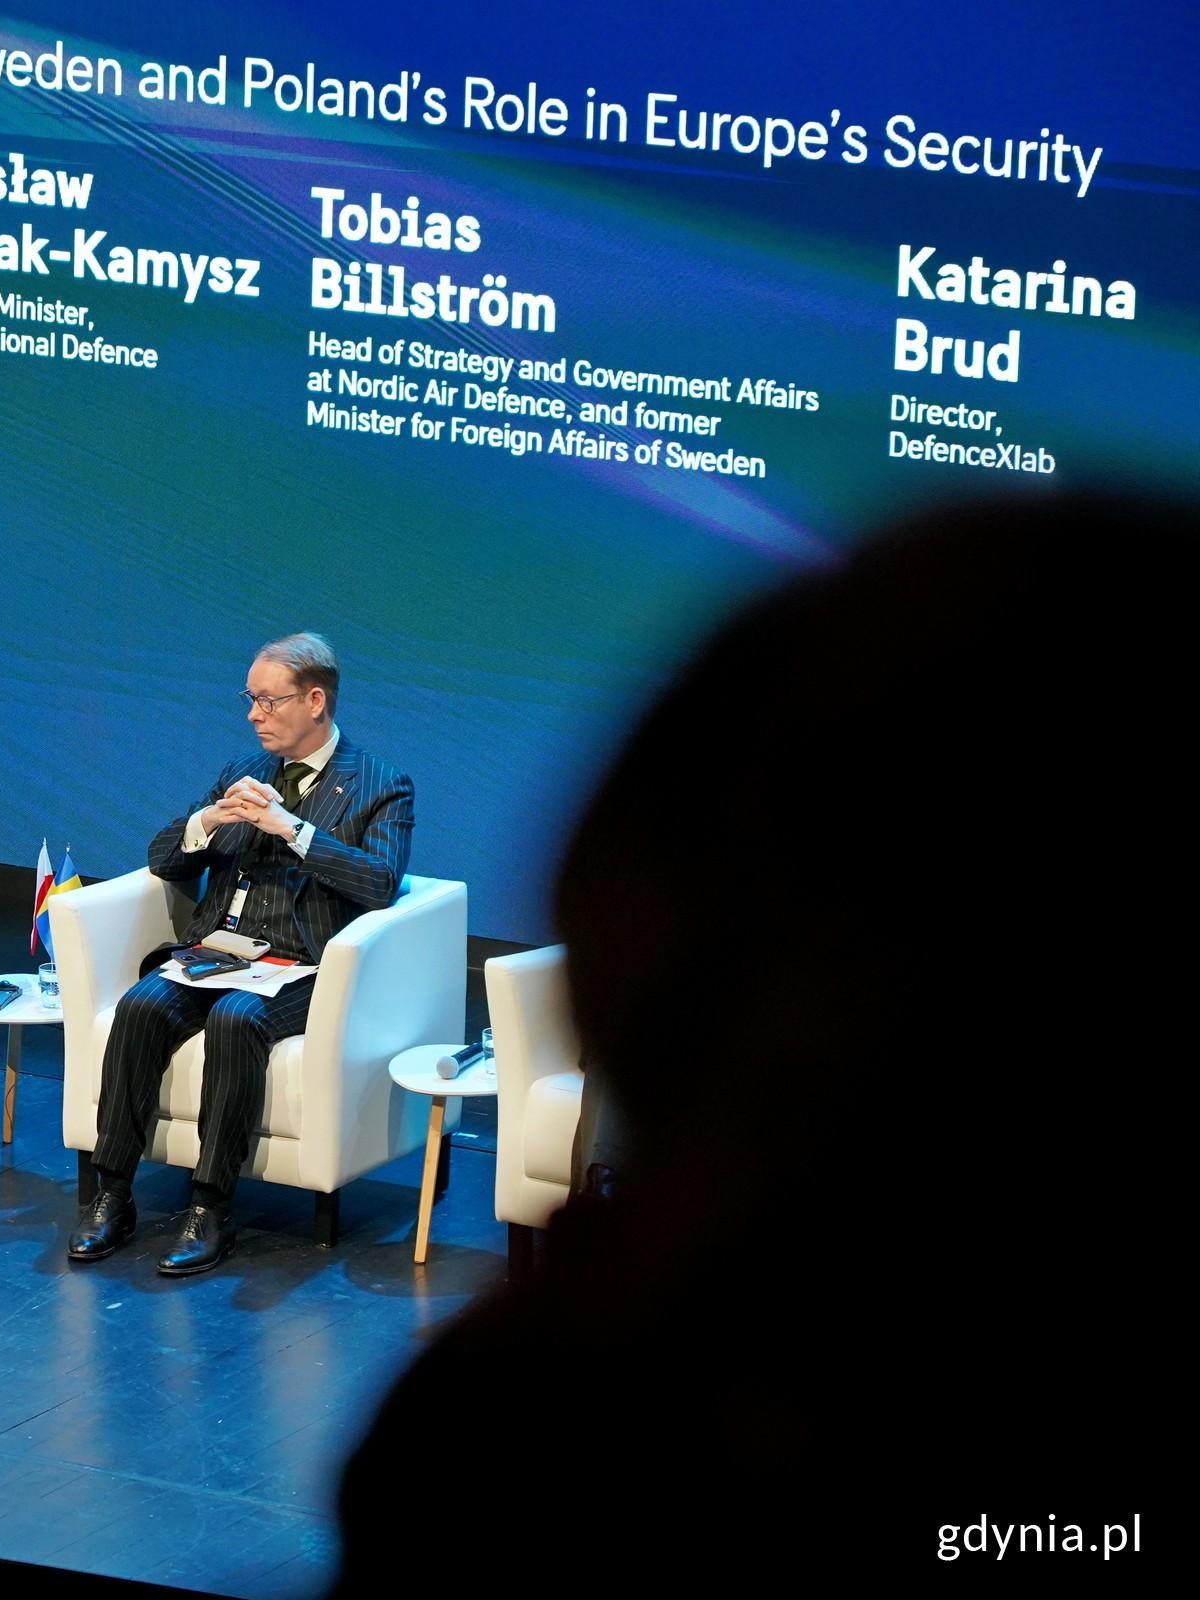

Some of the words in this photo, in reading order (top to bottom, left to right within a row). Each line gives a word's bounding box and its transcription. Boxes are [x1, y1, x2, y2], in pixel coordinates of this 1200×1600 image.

[138, 54, 227, 106] and
[244, 57, 448, 125] Poland’s
[464, 77, 569, 136] Role
[586, 87, 628, 142] in
[646, 93, 868, 169] Europe’s
[883, 115, 1103, 198] Security
[311, 187, 482, 253] Tobias
[311, 257, 556, 333] Billström
[897, 245, 1136, 320] Katarina
[62, 333, 159, 369] Defence
[308, 331, 373, 362] Head
[378, 339, 406, 366] of
[408, 342, 515, 383] Strategy
[518, 357, 567, 384] and
[573, 359, 732, 402] Government
[735, 377, 820, 412] Affairs
[894, 317, 1021, 383] Brud
[306, 368, 333, 393] at
[338, 368, 419, 402] Nordic
[423, 379, 459, 407] Air
[464, 383, 573, 424] Defence,
[579, 401, 628, 427] and
[634, 402, 722, 436] former
[890, 394, 1003, 437] Director,
[307, 400, 406, 436] Minister
[410, 412, 446, 441] for
[450, 417, 543, 456] Foreign
[547, 428, 630, 462] Affairs
[634, 439, 663, 466] of
[665, 442, 766, 478] Sweden
[889, 430, 1056, 474] DefenceXlab
